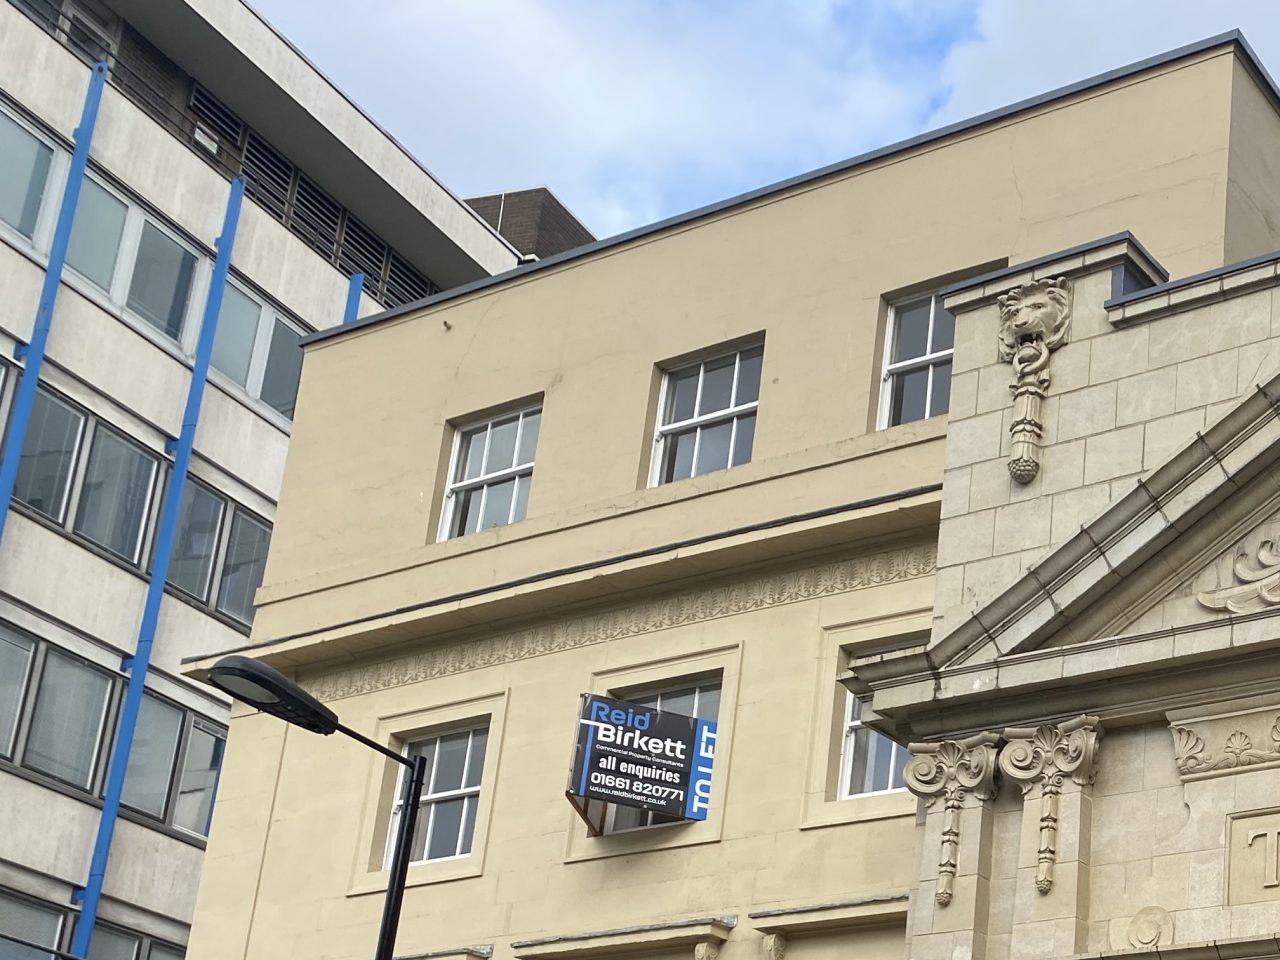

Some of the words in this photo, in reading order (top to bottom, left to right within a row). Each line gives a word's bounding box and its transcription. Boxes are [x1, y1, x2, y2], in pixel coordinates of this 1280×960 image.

[591, 701, 651, 730] Reid
[596, 744, 628, 756] Commercial
[628, 751, 652, 762] Property
[652, 757, 684, 768] Consultants
[597, 725, 687, 760] Birkett
[599, 755, 616, 770] all
[619, 761, 681, 784] enquiries
[589, 785, 667, 806] www.reidbirkett.co.uk
[591, 772, 631, 792] 01661
[632, 781, 684, 801] 820771
